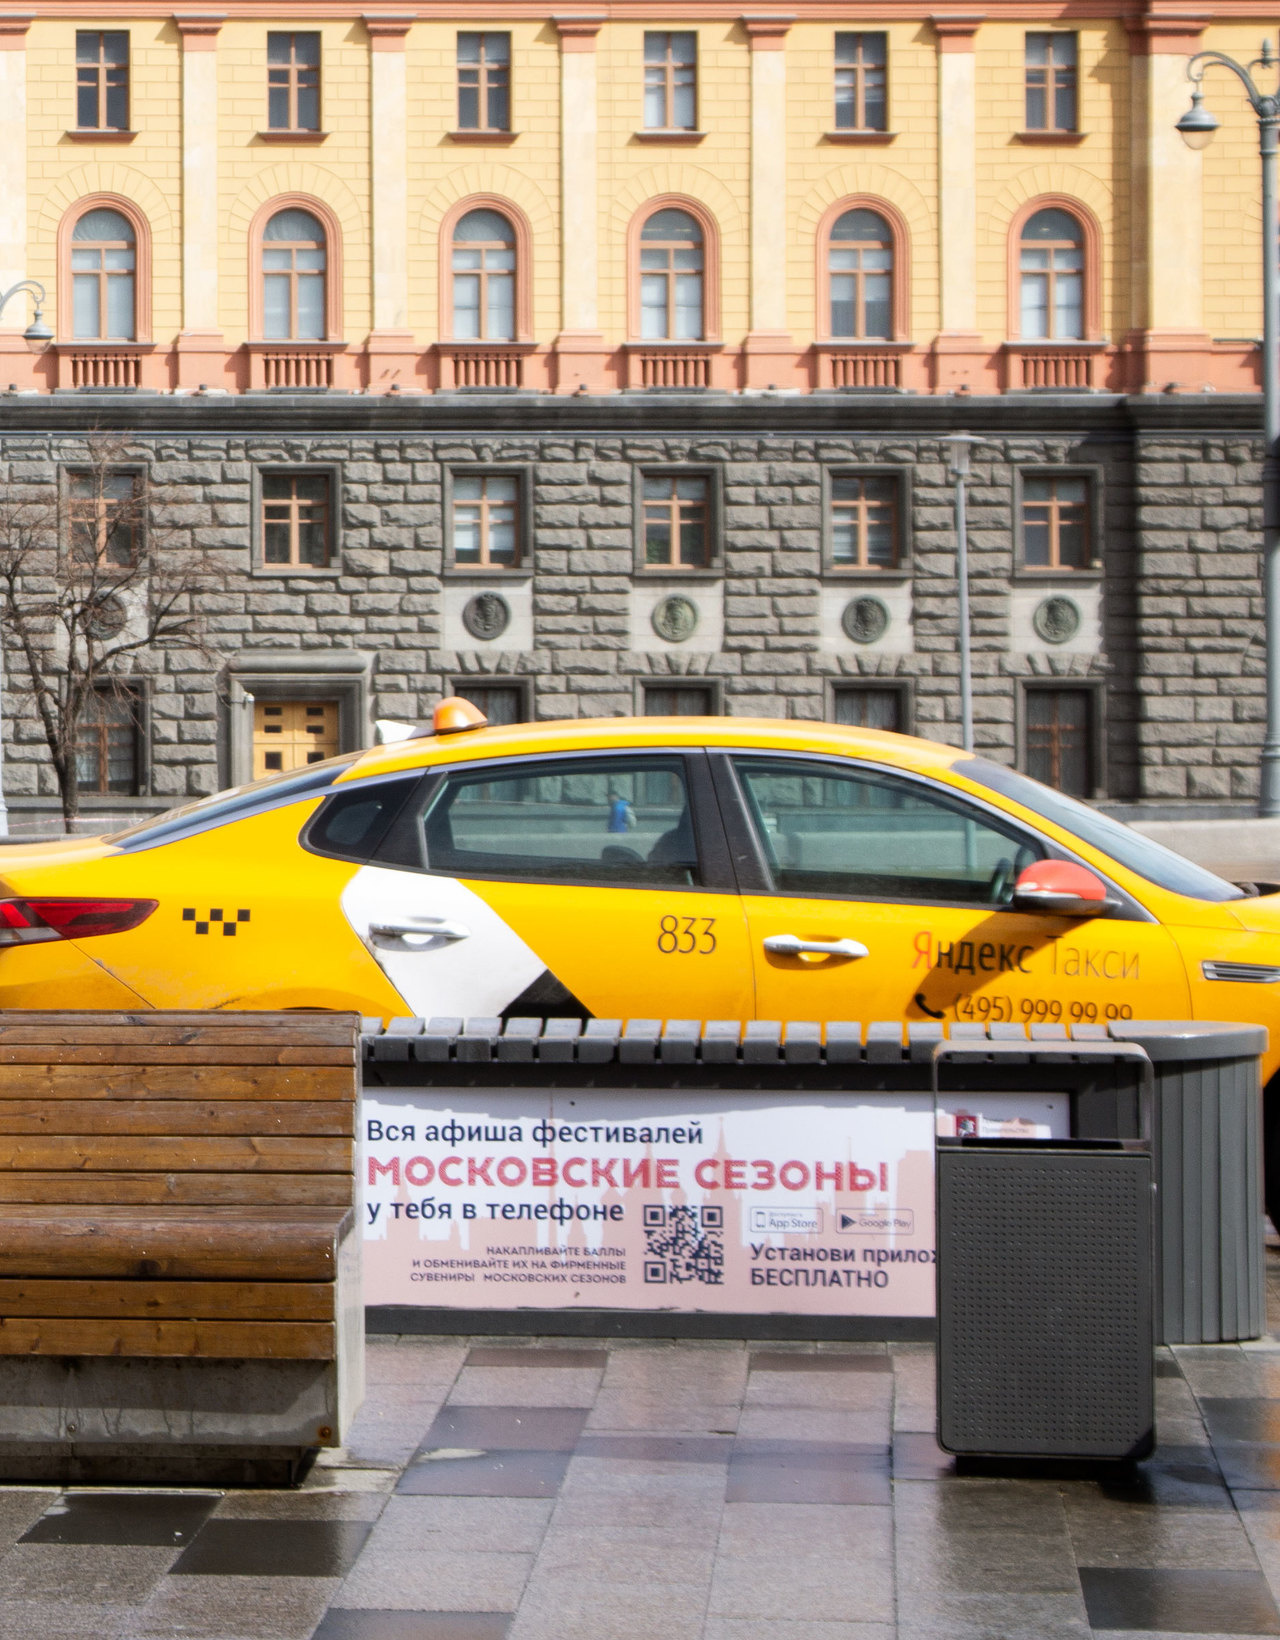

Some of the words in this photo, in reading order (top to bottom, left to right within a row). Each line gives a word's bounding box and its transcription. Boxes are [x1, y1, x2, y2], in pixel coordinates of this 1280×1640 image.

[657, 914, 717, 955] 833
[912, 930, 1034, 976] Яндекс
[1045, 934, 1140, 980] Такси
[954, 993, 1013, 1022] (495)
[1021, 998, 1062, 1023] 999
[1070, 1001, 1098, 1023] 99
[367, 1119, 416, 1141] Вся
[425, 1118, 523, 1147] афиша
[532, 1118, 703, 1148] фестивалей
[368, 1156, 680, 1189] МОСКОВСКИЕ
[694, 1159, 889, 1192] СЕЗОНЫ
[367, 1202, 381, 1225] у
[390, 1197, 452, 1219] тебя
[463, 1203, 477, 1219] в
[487, 1198, 624, 1226] телефоне
[770, 1218, 789, 1229] App
[791, 1218, 818, 1228] Store
[859, 1218, 892, 1230] Google
[894, 1218, 912, 1230] Play
[486, 1245, 580, 1256] НАКАПЛИВАЙТЕ
[583, 1246, 626, 1257] БАЛЛЫ
[750, 1242, 856, 1263] Установи
[412, 1259, 420, 1268] И
[423, 1257, 510, 1269] ОБМЕНИВАЙТЕ
[512, 1260, 528, 1269] ИХ
[531, 1260, 547, 1269] НА
[550, 1260, 627, 1271] ФИРМЕННЫЕ
[410, 1272, 475, 1282] СУВЕНИРЫ
[483, 1273, 567, 1283] МОСКОВСКИХ
[570, 1273, 627, 1284] СЕЗОНОВ
[751, 1267, 889, 1288] БЕСПЛАТНО
